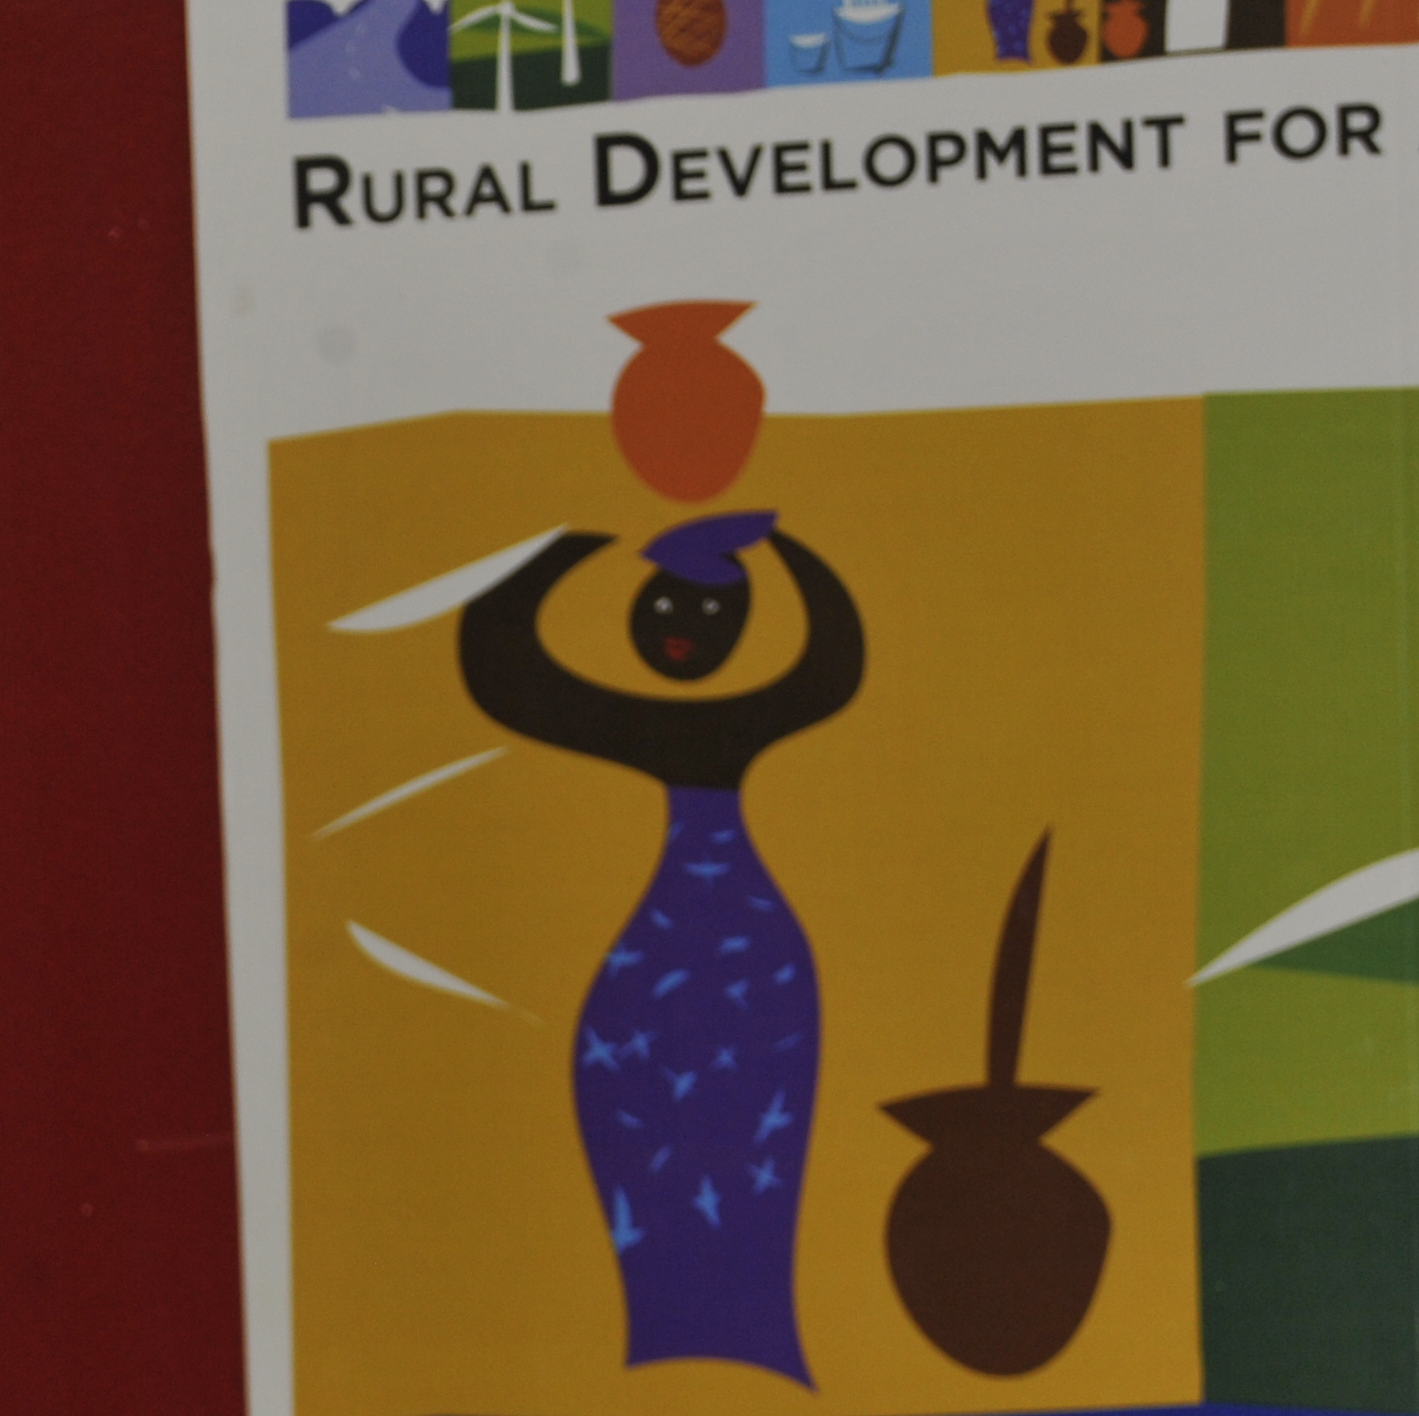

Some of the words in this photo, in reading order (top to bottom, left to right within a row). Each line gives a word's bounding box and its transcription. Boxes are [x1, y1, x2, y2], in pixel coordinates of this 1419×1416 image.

[292, 154, 557, 231] RURAL
[593, 114, 1187, 208] DEVELOPMENT
[1224, 102, 1383, 165] FOR
